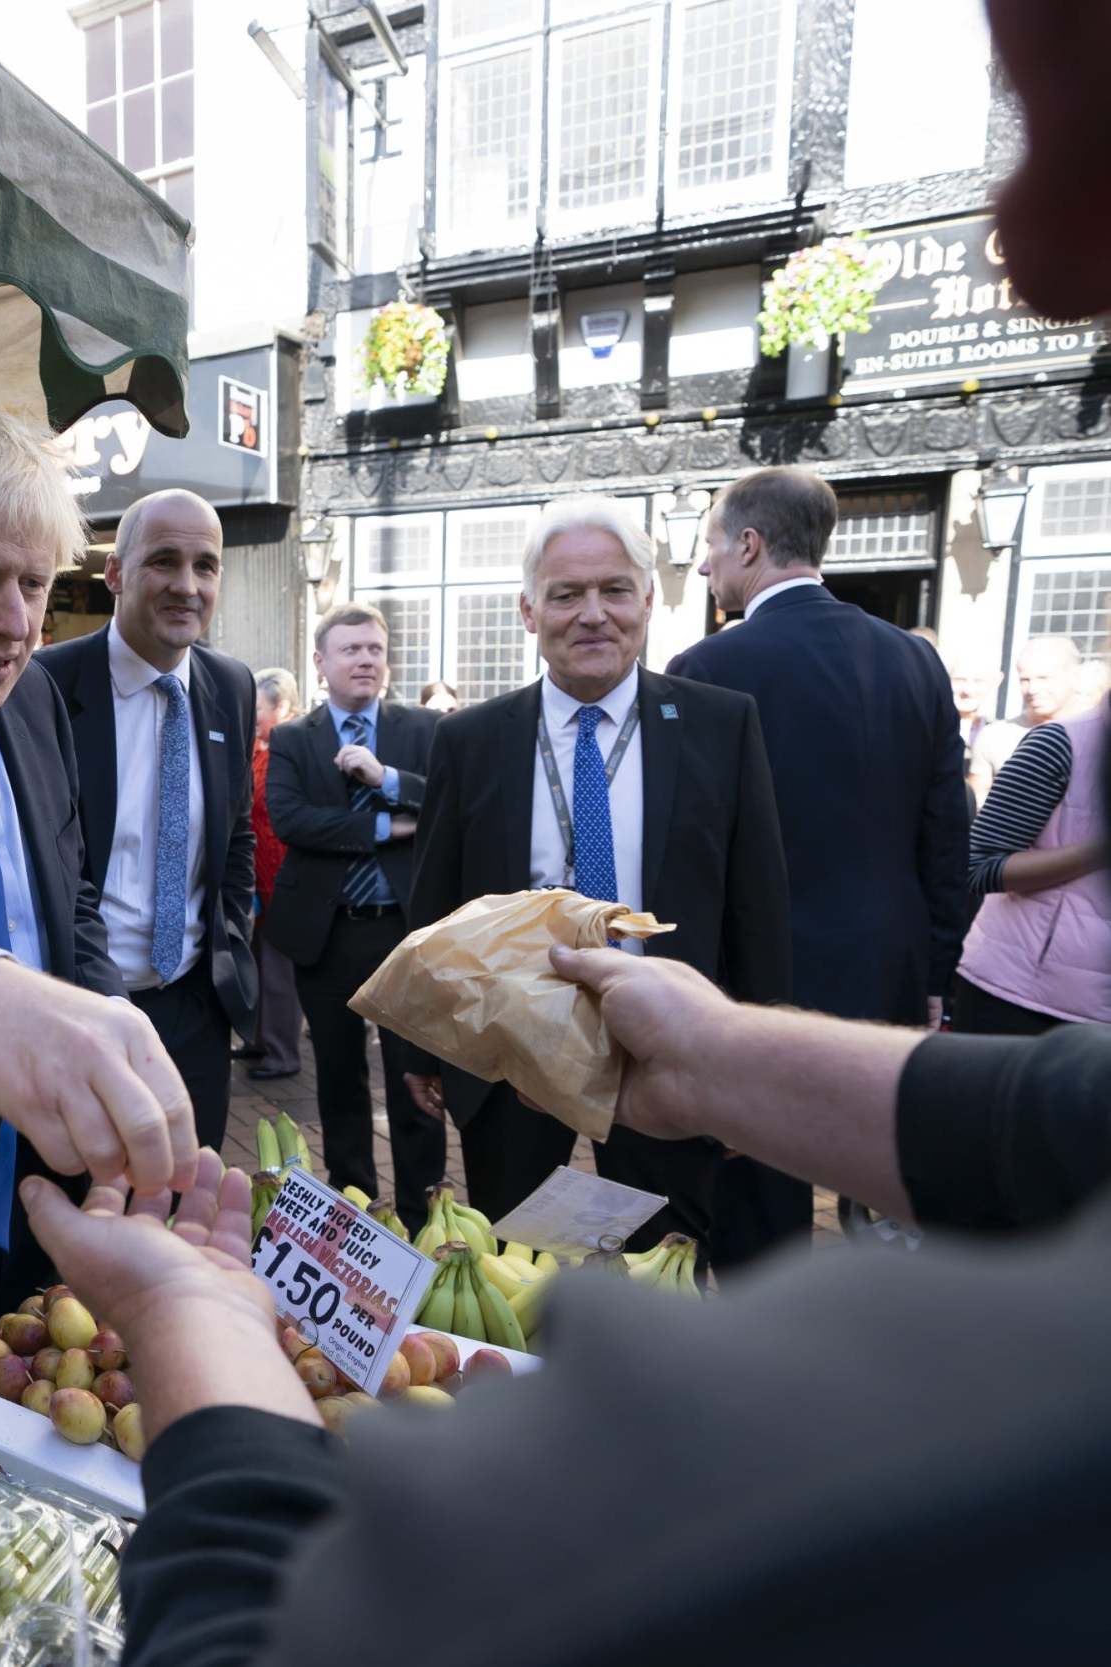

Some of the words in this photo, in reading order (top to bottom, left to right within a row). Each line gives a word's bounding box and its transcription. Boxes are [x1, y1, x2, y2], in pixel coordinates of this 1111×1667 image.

[931, 274, 1029, 319] Hot
[855, 347, 954, 374] EN-SUITE
[958, 337, 1039, 363] ROOMS
[1043, 333, 1079, 352] TO
[890, 322, 979, 350] DOUBLE
[982, 320, 1001, 338] &
[275, 1193, 310, 1222] WEET
[308, 1217, 337, 1242] AND
[338, 1238, 381, 1270] JUICY
[283, 1177, 325, 1211] RESHLY
[324, 1205, 378, 1246] PICKED!
[265, 1209, 319, 1252] NGLISH
[319, 1245, 398, 1314] VICTORIAS
[350, 1303, 376, 1330] PER
[332, 1318, 376, 1357] POUND
[347, 1352, 368, 1373] English
